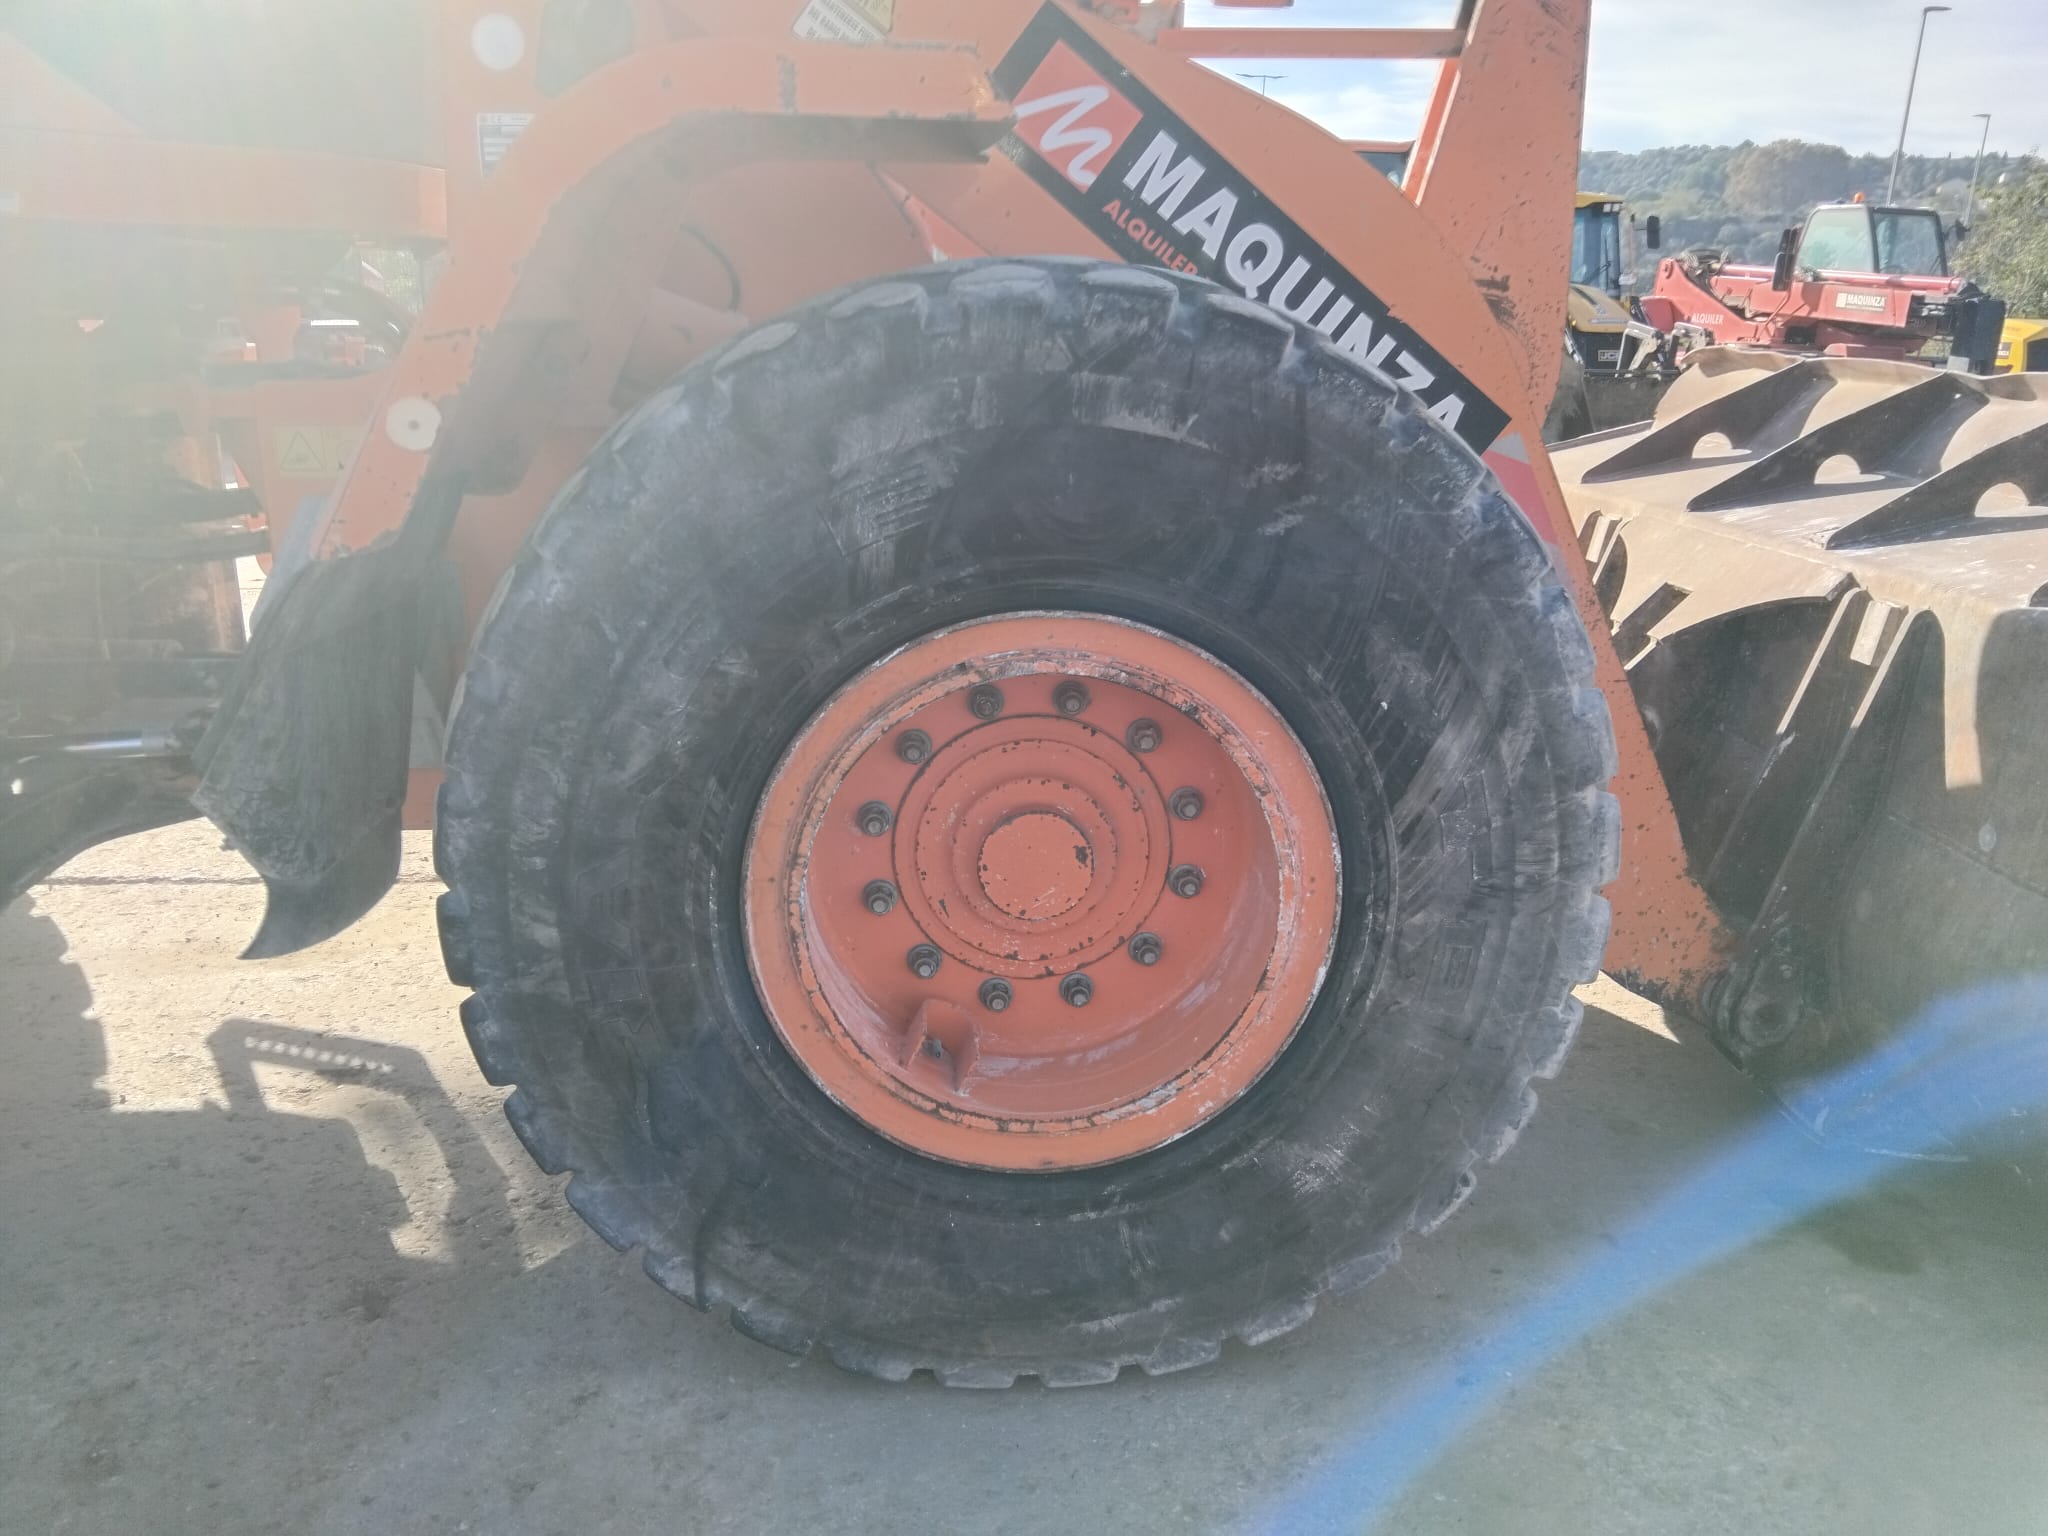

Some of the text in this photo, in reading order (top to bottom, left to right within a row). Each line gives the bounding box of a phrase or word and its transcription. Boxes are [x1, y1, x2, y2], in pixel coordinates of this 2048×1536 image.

[1123, 129, 1465, 431] MAQUINZA
[1846, 294, 1886, 307] MAQUINZA
[1691, 312, 1724, 325] ALQUILER
